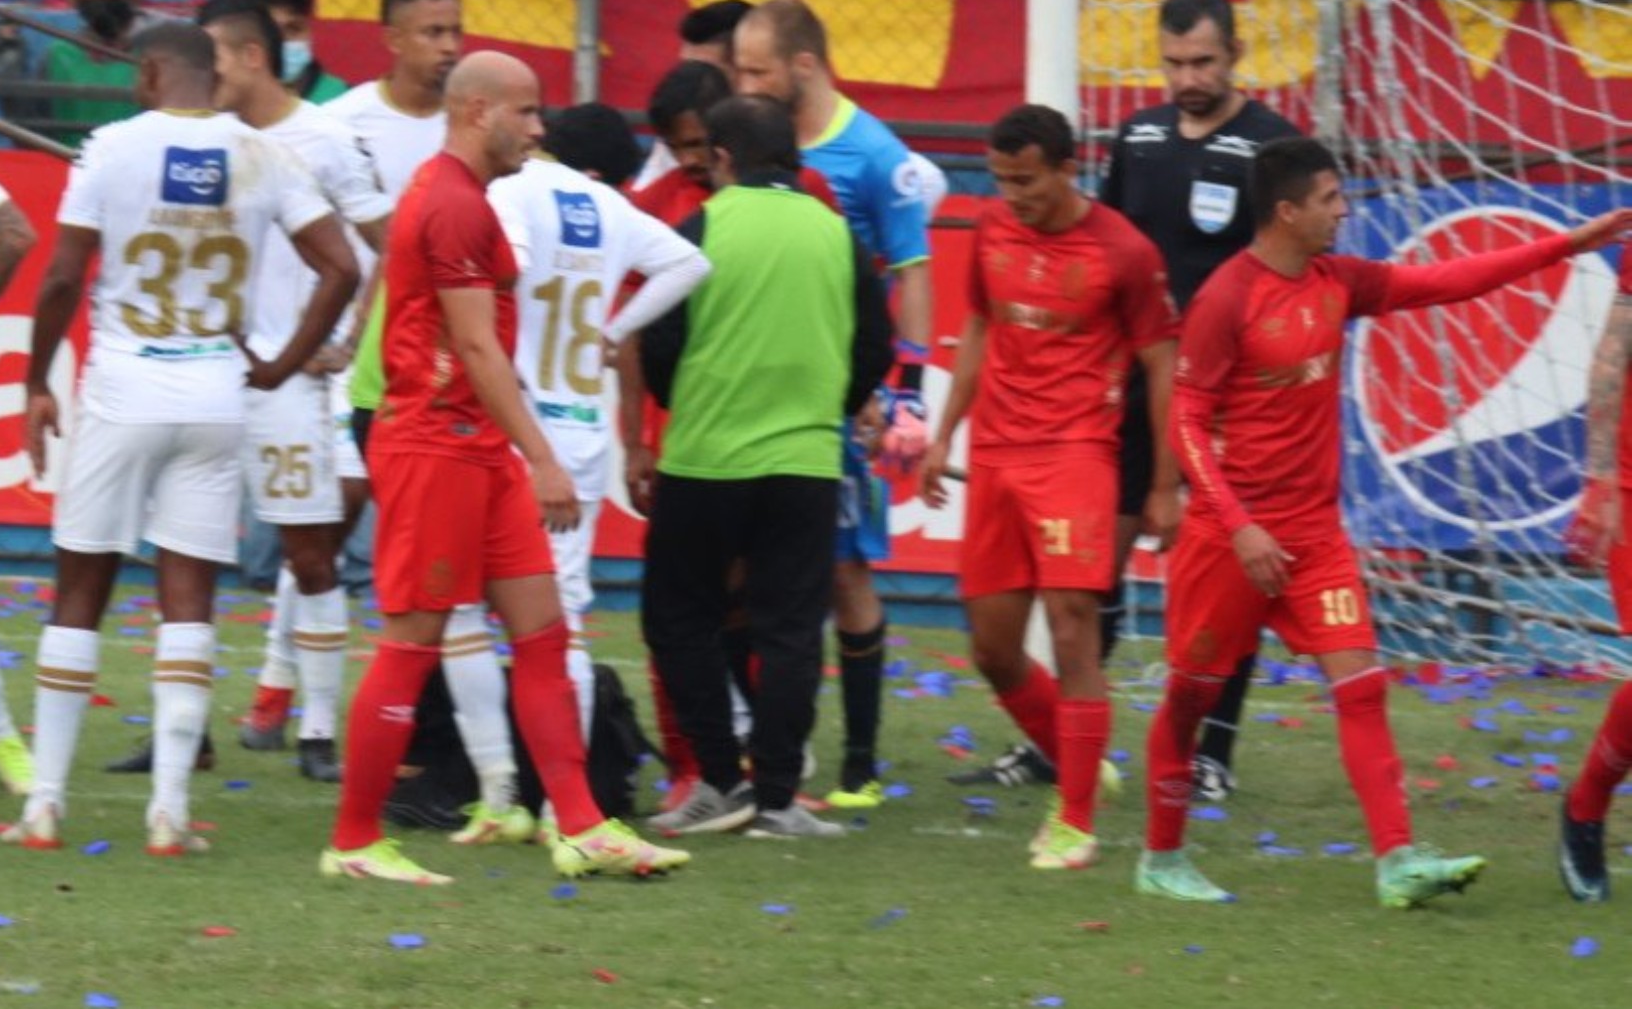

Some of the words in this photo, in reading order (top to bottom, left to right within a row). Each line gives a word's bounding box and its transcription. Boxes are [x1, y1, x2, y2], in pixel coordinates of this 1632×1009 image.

[121, 232, 250, 338] 33
[532, 275, 604, 396] 18
[261, 444, 313, 499] 25
[1319, 587, 1360, 626] 10
